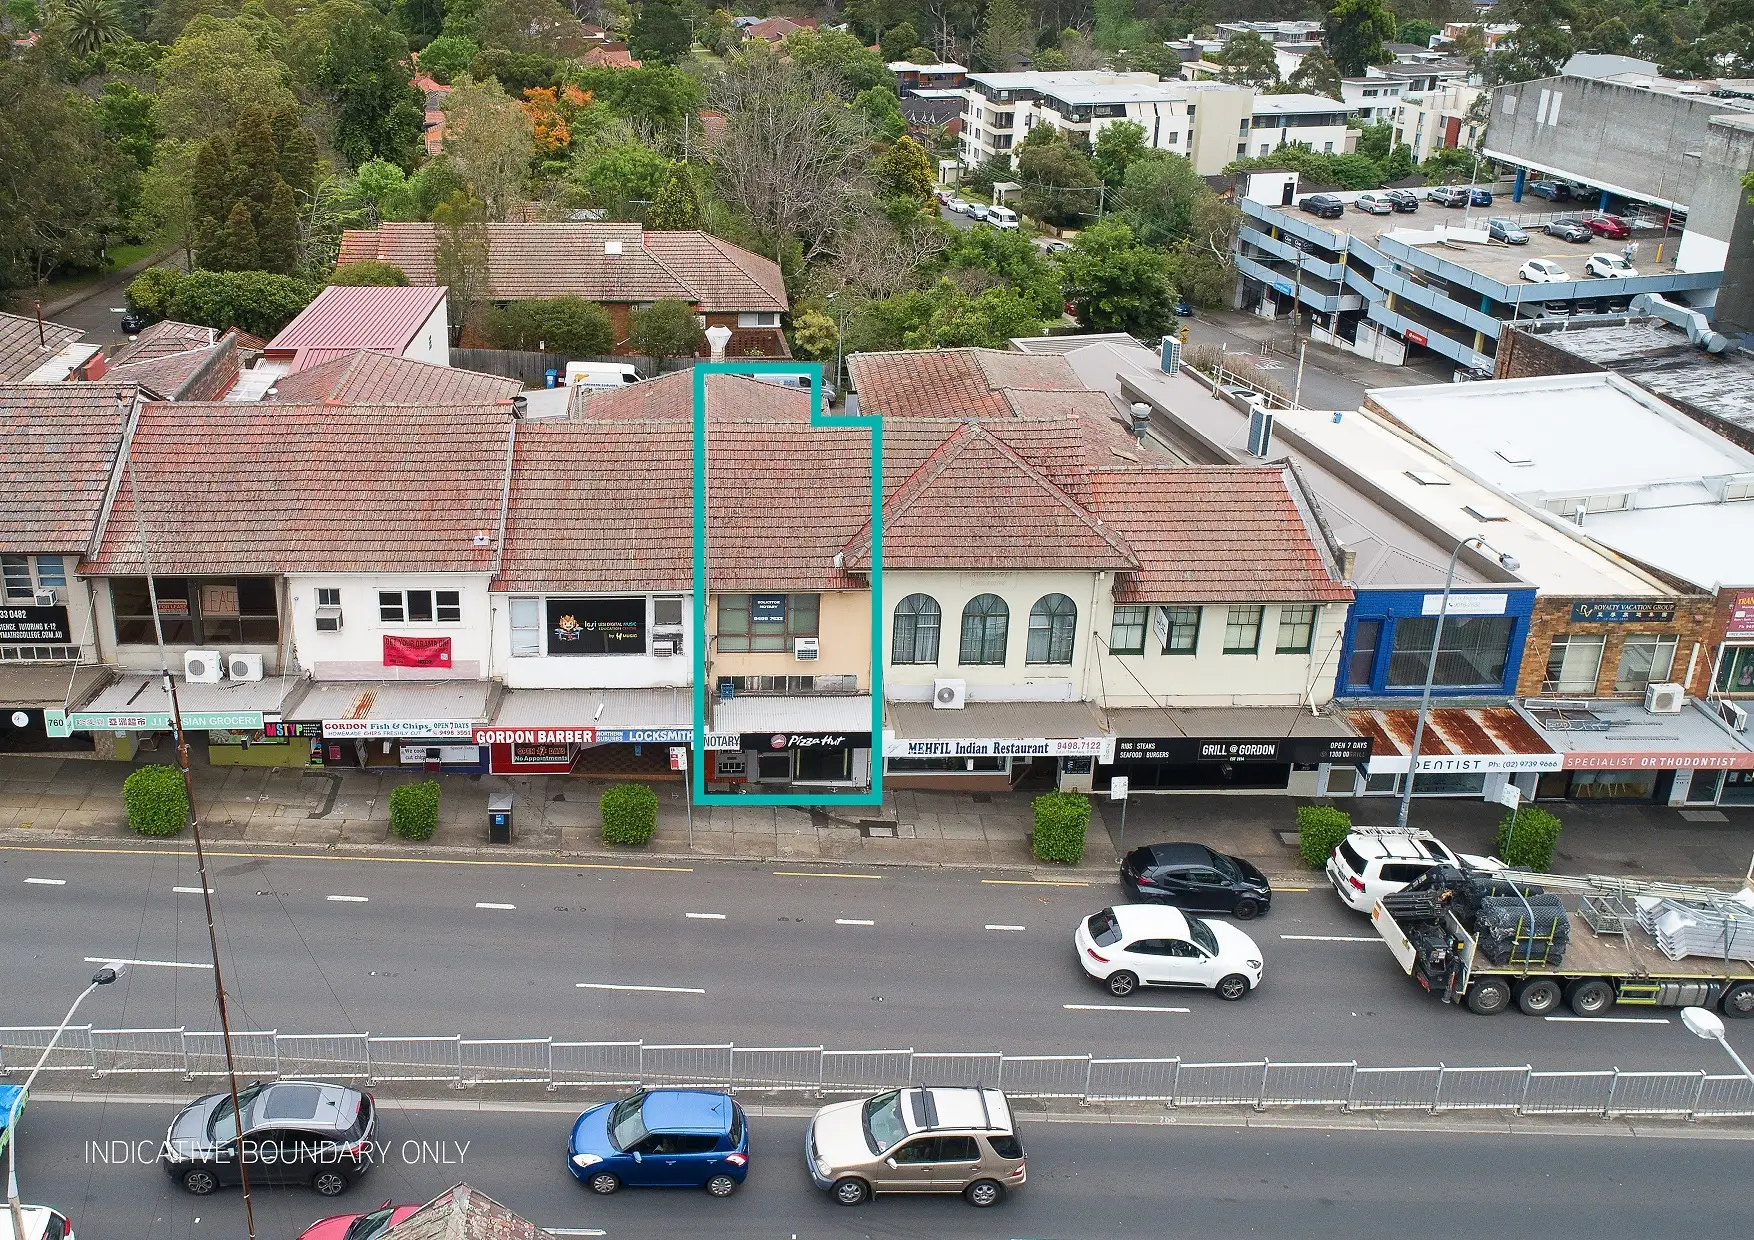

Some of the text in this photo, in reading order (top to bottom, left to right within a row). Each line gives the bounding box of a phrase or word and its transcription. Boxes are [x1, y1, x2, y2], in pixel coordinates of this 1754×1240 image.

[9, 610, 27, 618] 0482
[48, 719, 64, 727] 760
[209, 715, 258, 726] GROCERY
[449, 722, 454, 730] 7
[266, 723, 303, 736] MSTYP
[476, 730, 593, 743] GORDON BARBER
[629, 730, 693, 741] LOCKSMITH
[787, 734, 846, 747] Pizza Hut
[704, 736, 740, 747] NOTARY
[1057, 741, 1101, 750] 9498.7122
[908, 741, 1049, 755] MEHFIL Indian Restaurant
[1202, 744, 1276, 755] GRILL @ GORDON
[1502, 760, 1518, 768] (02)
[1567, 757, 1635, 766] SPECIALIST
